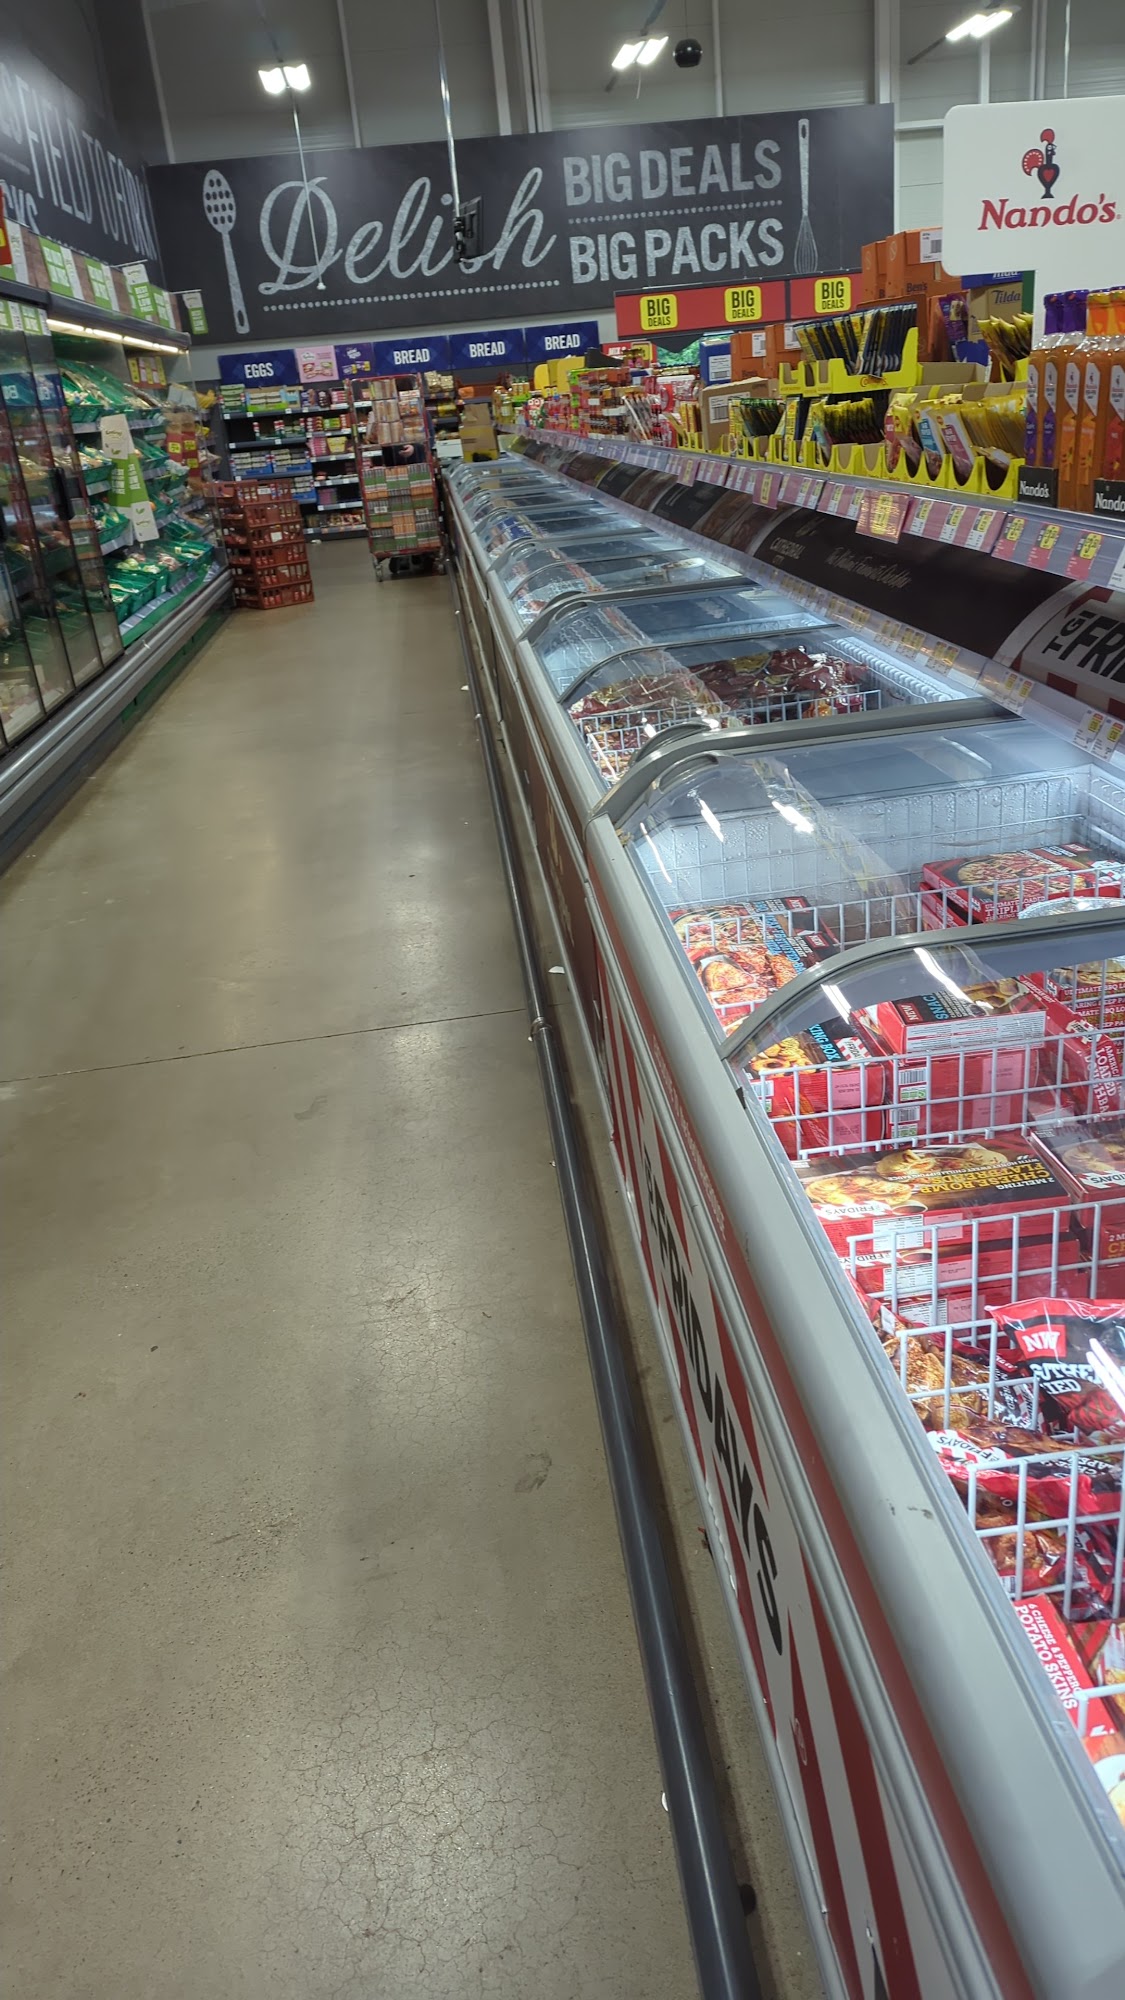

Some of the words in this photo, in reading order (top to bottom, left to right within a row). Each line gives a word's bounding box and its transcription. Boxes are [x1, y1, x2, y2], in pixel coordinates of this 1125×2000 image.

[563, 152, 633, 206] BIG
[639, 139, 782, 200] DEALS
[977, 192, 1116, 230] Nando's
[259, 166, 557, 296] Delih
[569, 231, 638, 284] BIG
[644, 218, 785, 277] PACKS
[731, 290, 755, 309] BIG
[821, 280, 845, 300] BIG
[991, 289, 1022, 304] Tilda
[647, 298, 671, 317] BIG
[731, 308, 755, 319] DEALS
[821, 299, 845, 310] DEALS
[647, 316, 671, 327] DEALS
[469, 341, 506, 358] BREAD
[544, 333, 581, 351] BREAD
[393, 348, 430, 366] BREAD
[244, 361, 274, 380] EGGS
[1019, 478, 1050, 498] Nando's
[1042, 610, 1097, 654] TGI
[901, 1003, 919, 1021] NEW
[922, 994, 950, 1020] SNAC
[808, 1024, 829, 1044] KING
[821, 1042, 842, 1060] BOX
[930, 1162, 1046, 1185] FLATBREADS
[979, 1170, 1050, 1187] CHEESE
[920, 1180, 975, 1194] BOMB
[995, 1178, 1048, 1190] MELTING
[825, 1205, 876, 1215] FRIDAYS
[650, 1172, 784, 1656] FRIDAYS
[1014, 1603, 1053, 1661] POTATO
[1044, 1662, 1079, 1710] SKINS
[1031, 1608, 1058, 1646] CHEESE
[1054, 1652, 1082, 1692] PEPPERO
